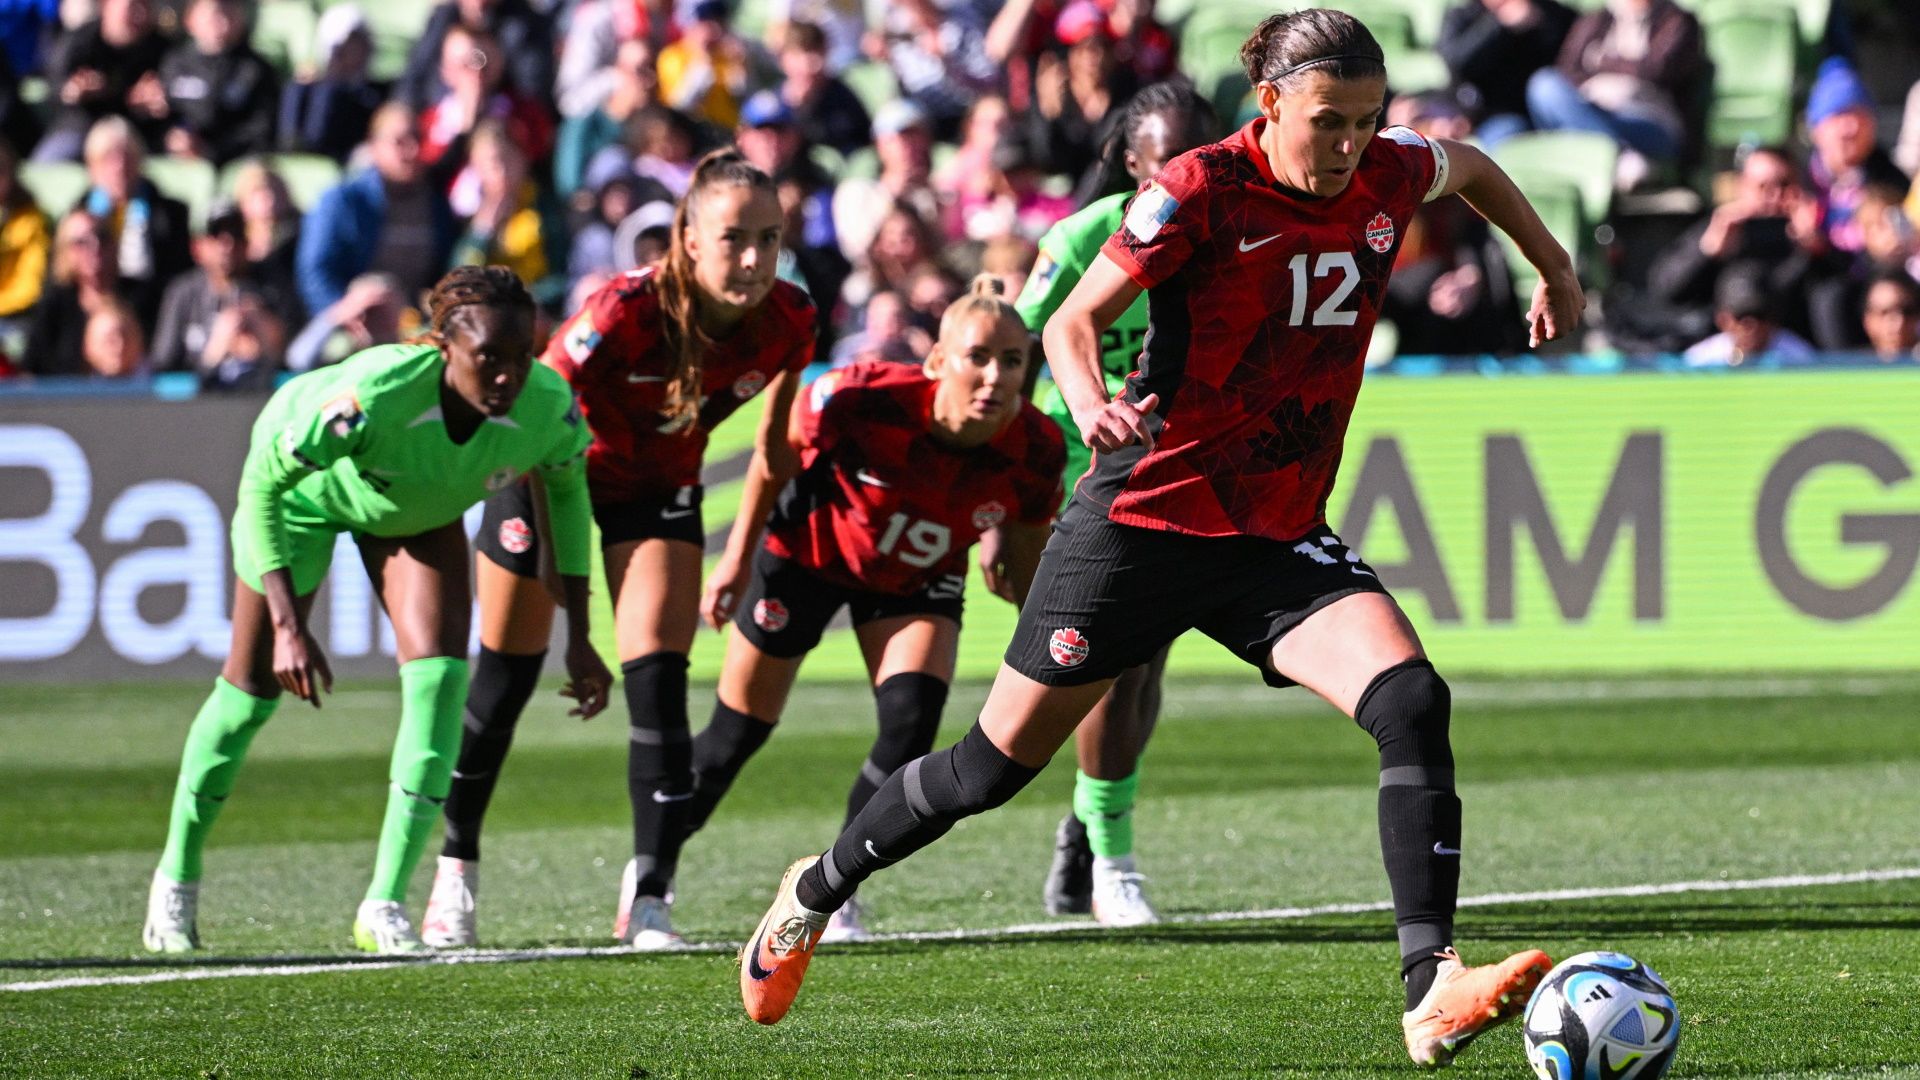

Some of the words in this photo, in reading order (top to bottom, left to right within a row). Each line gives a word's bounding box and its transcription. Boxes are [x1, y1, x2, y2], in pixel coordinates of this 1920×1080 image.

[1367, 228, 1393, 239] CANADA
[1288, 251, 1361, 326] 12
[877, 512, 951, 568] 19
[1051, 639, 1088, 655] CANADA
